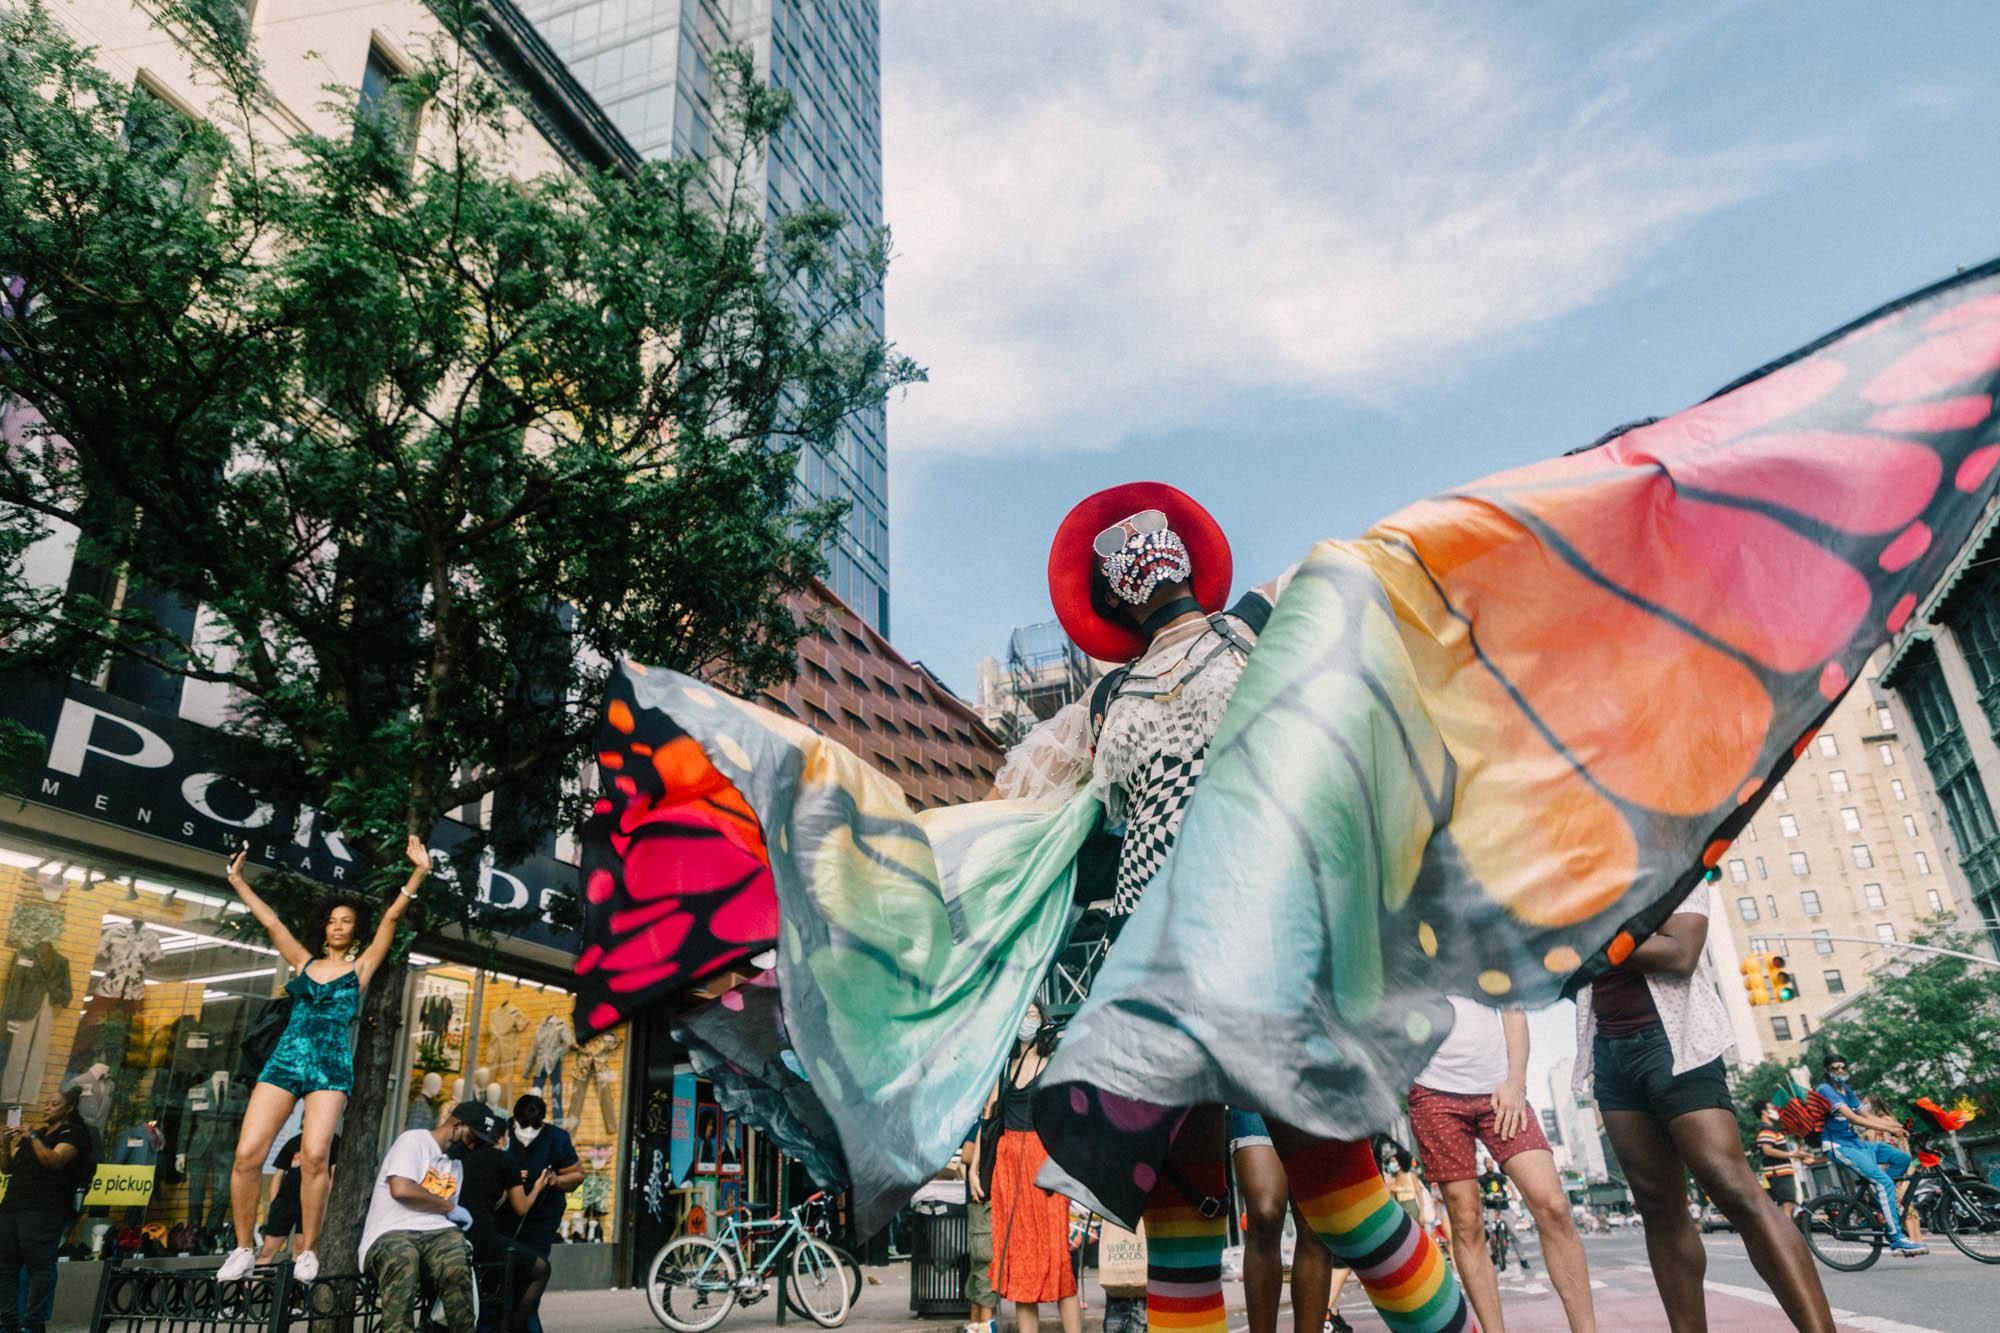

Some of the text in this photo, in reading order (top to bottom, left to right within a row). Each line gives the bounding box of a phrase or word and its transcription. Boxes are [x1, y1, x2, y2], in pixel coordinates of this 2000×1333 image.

[41, 777, 345, 881] MENSWEAR
[105, 1173, 153, 1194] pickup
[1107, 1241, 1142, 1252] WHOLE
